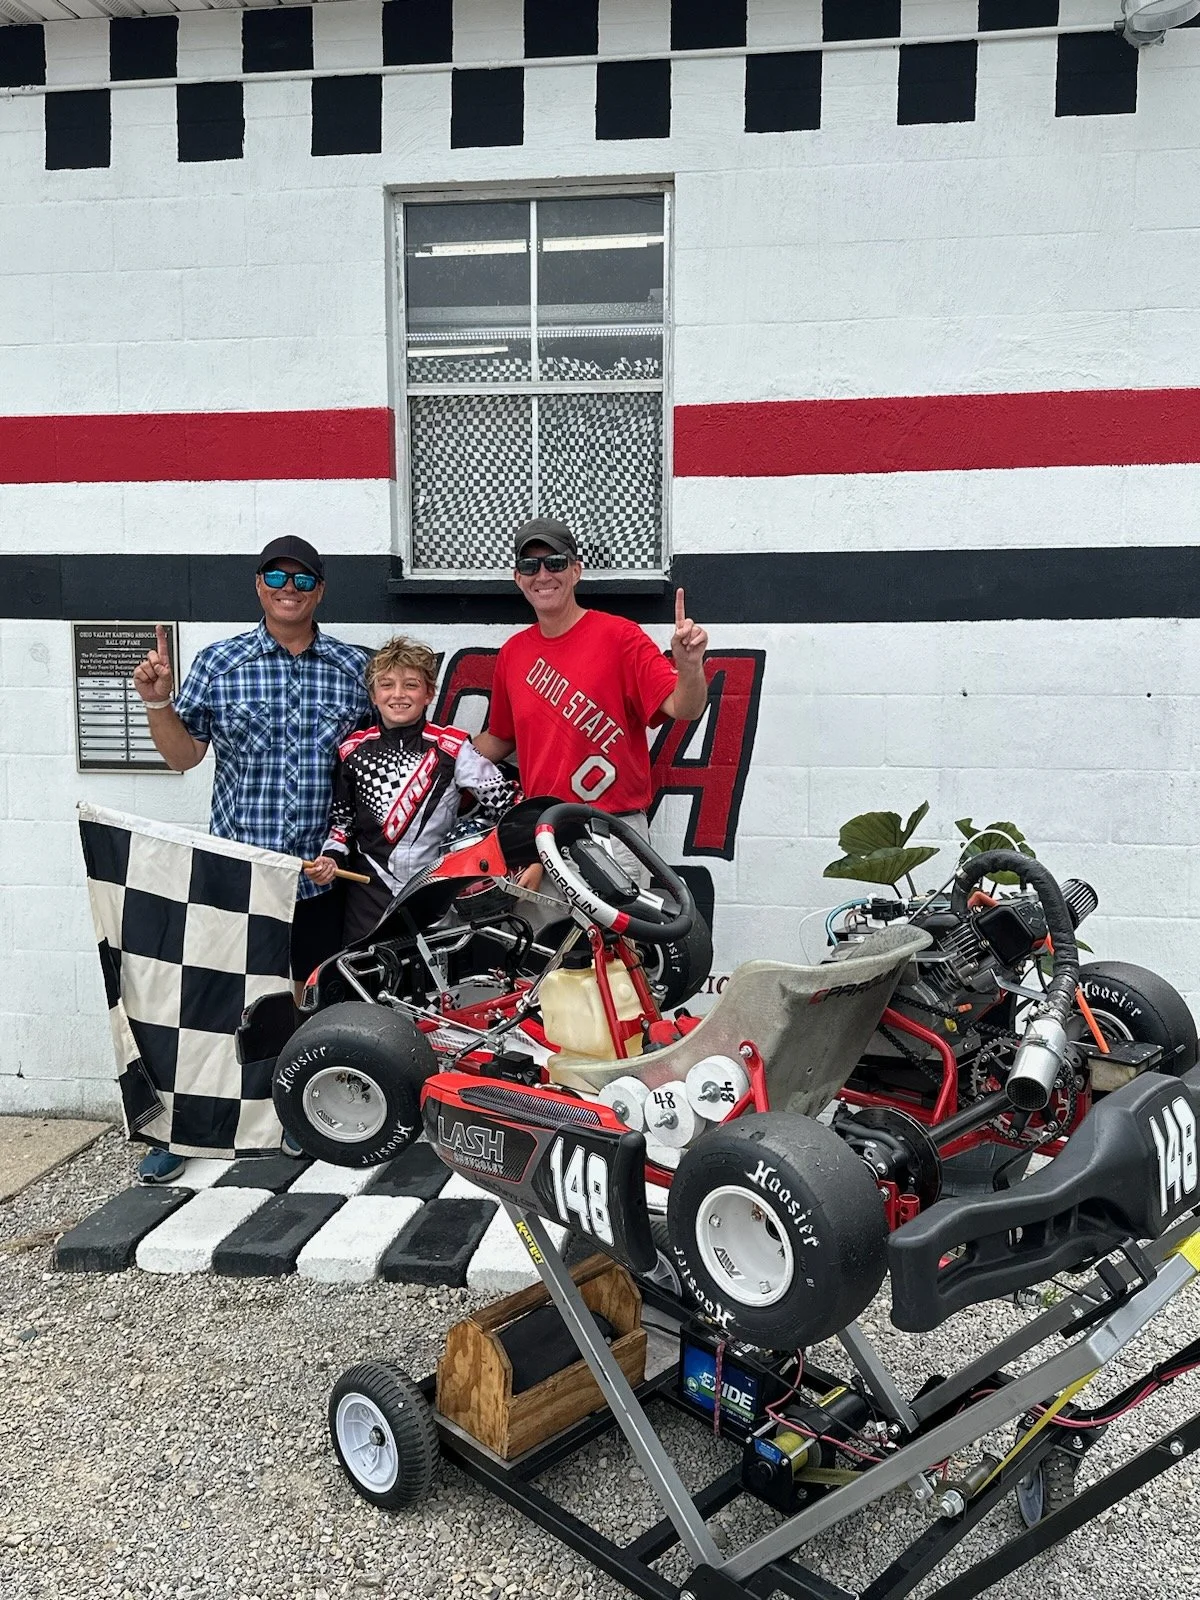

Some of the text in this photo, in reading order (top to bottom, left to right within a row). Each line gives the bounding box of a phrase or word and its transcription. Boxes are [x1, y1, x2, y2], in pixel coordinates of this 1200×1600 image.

[526, 657, 570, 707] OHIO
[562, 690, 625, 754] STATE
[543, 858, 599, 916] PAROLIN
[1078, 980, 1142, 1017] Hoosier
[277, 1046, 326, 1093] Hoosier
[653, 1091, 676, 1109] 48
[362, 1120, 414, 1164] Hoosier
[438, 1115, 505, 1163] LASH
[1148, 1096, 1197, 1216] 148
[550, 1136, 615, 1247] 148
[744, 1160, 820, 1248] Hoosier
[673, 1246, 736, 1329] Hoosier
